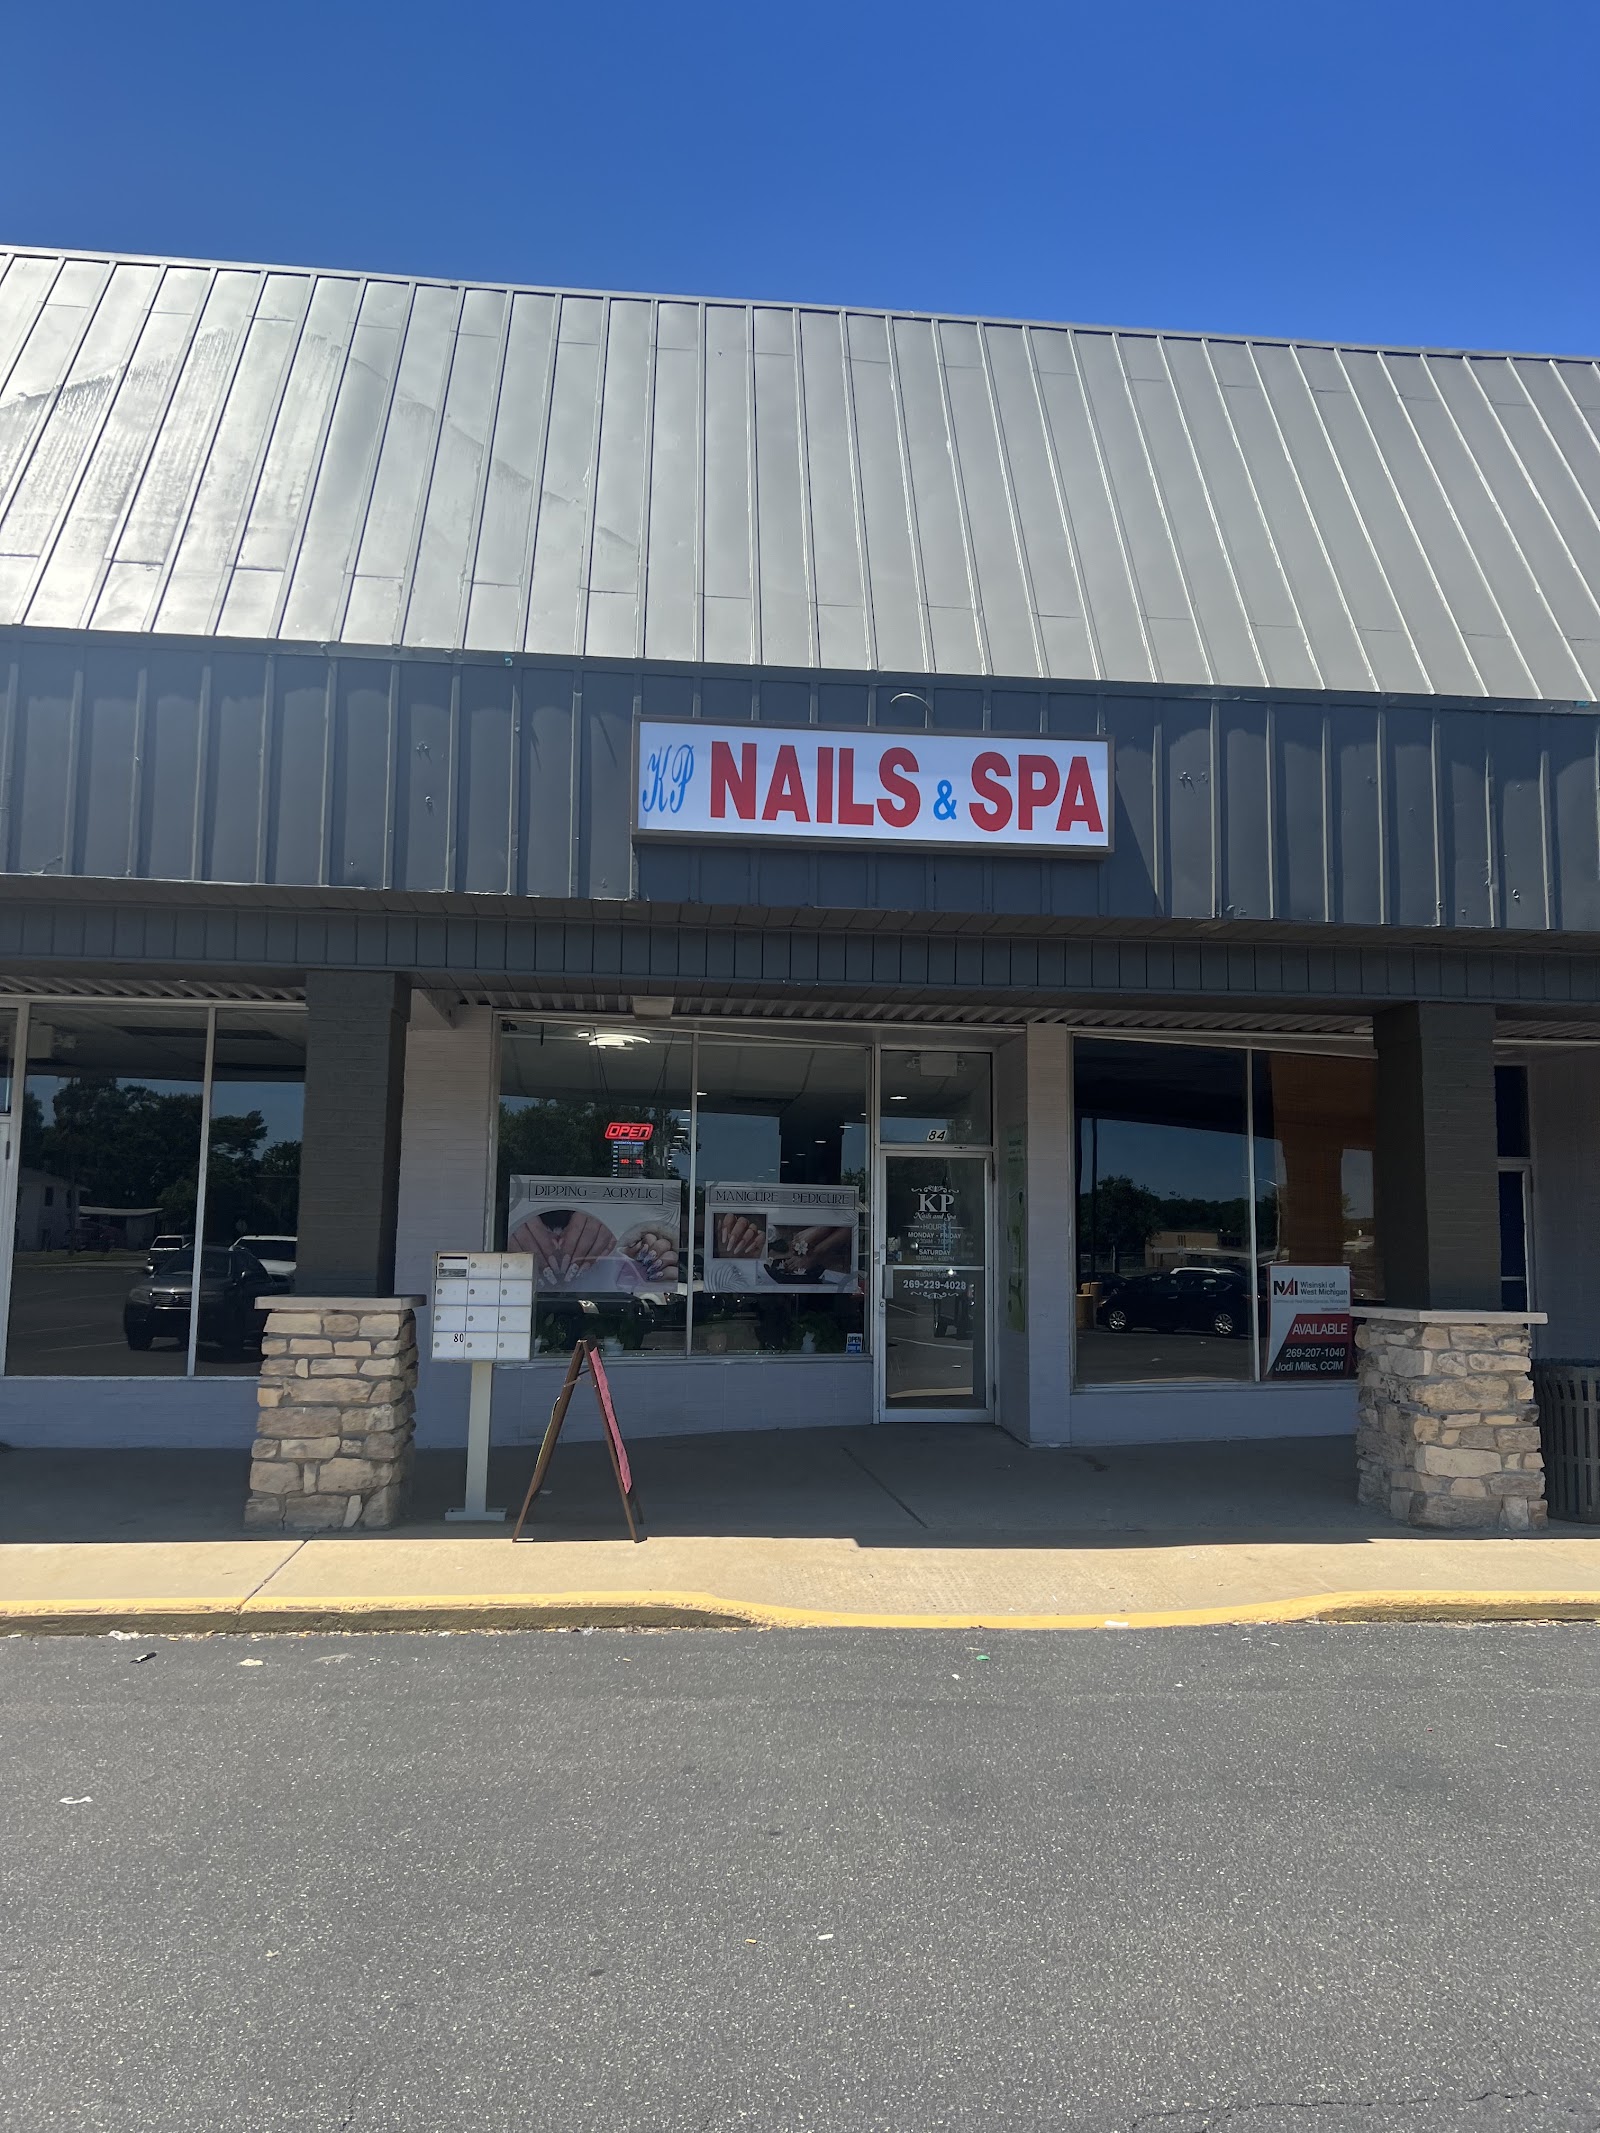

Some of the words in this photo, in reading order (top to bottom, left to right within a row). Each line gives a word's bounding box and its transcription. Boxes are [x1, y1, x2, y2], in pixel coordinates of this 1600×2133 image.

[710, 741, 921, 827] NAILS
[933, 780, 957, 820] &
[969, 752, 1104, 832] SPA
[609, 1126, 650, 1137] OPEN
[929, 1130, 946, 1141] 84
[535, 1185, 587, 1197] DIPPING
[602, 1187, 658, 1199] ACRYLIC
[716, 1190, 779, 1203] MANICURE
[792, 1192, 849, 1205] PEDICURE
[918, 1193, 955, 1213] KP
[913, 1211, 932, 1221] Nails
[944, 1212, 957, 1221] Spa
[922, 1223, 947, 1231] HOURS
[903, 1280, 967, 1290] 269-229-4028
[1273, 1277, 1299, 1296] NAI
[1329, 1281, 1336, 1289] of
[1300, 1288, 1317, 1296] West
[1318, 1288, 1348, 1297] Michigan
[1292, 1323, 1348, 1335] AVAILABLE
[453, 1333, 465, 1343] 80
[1286, 1348, 1346, 1358] 269-207-1040
[1276, 1362, 1294, 1372] Jodi
[1295, 1361, 1319, 1372] Milks,
[1320, 1361, 1344, 1371] CCIM
